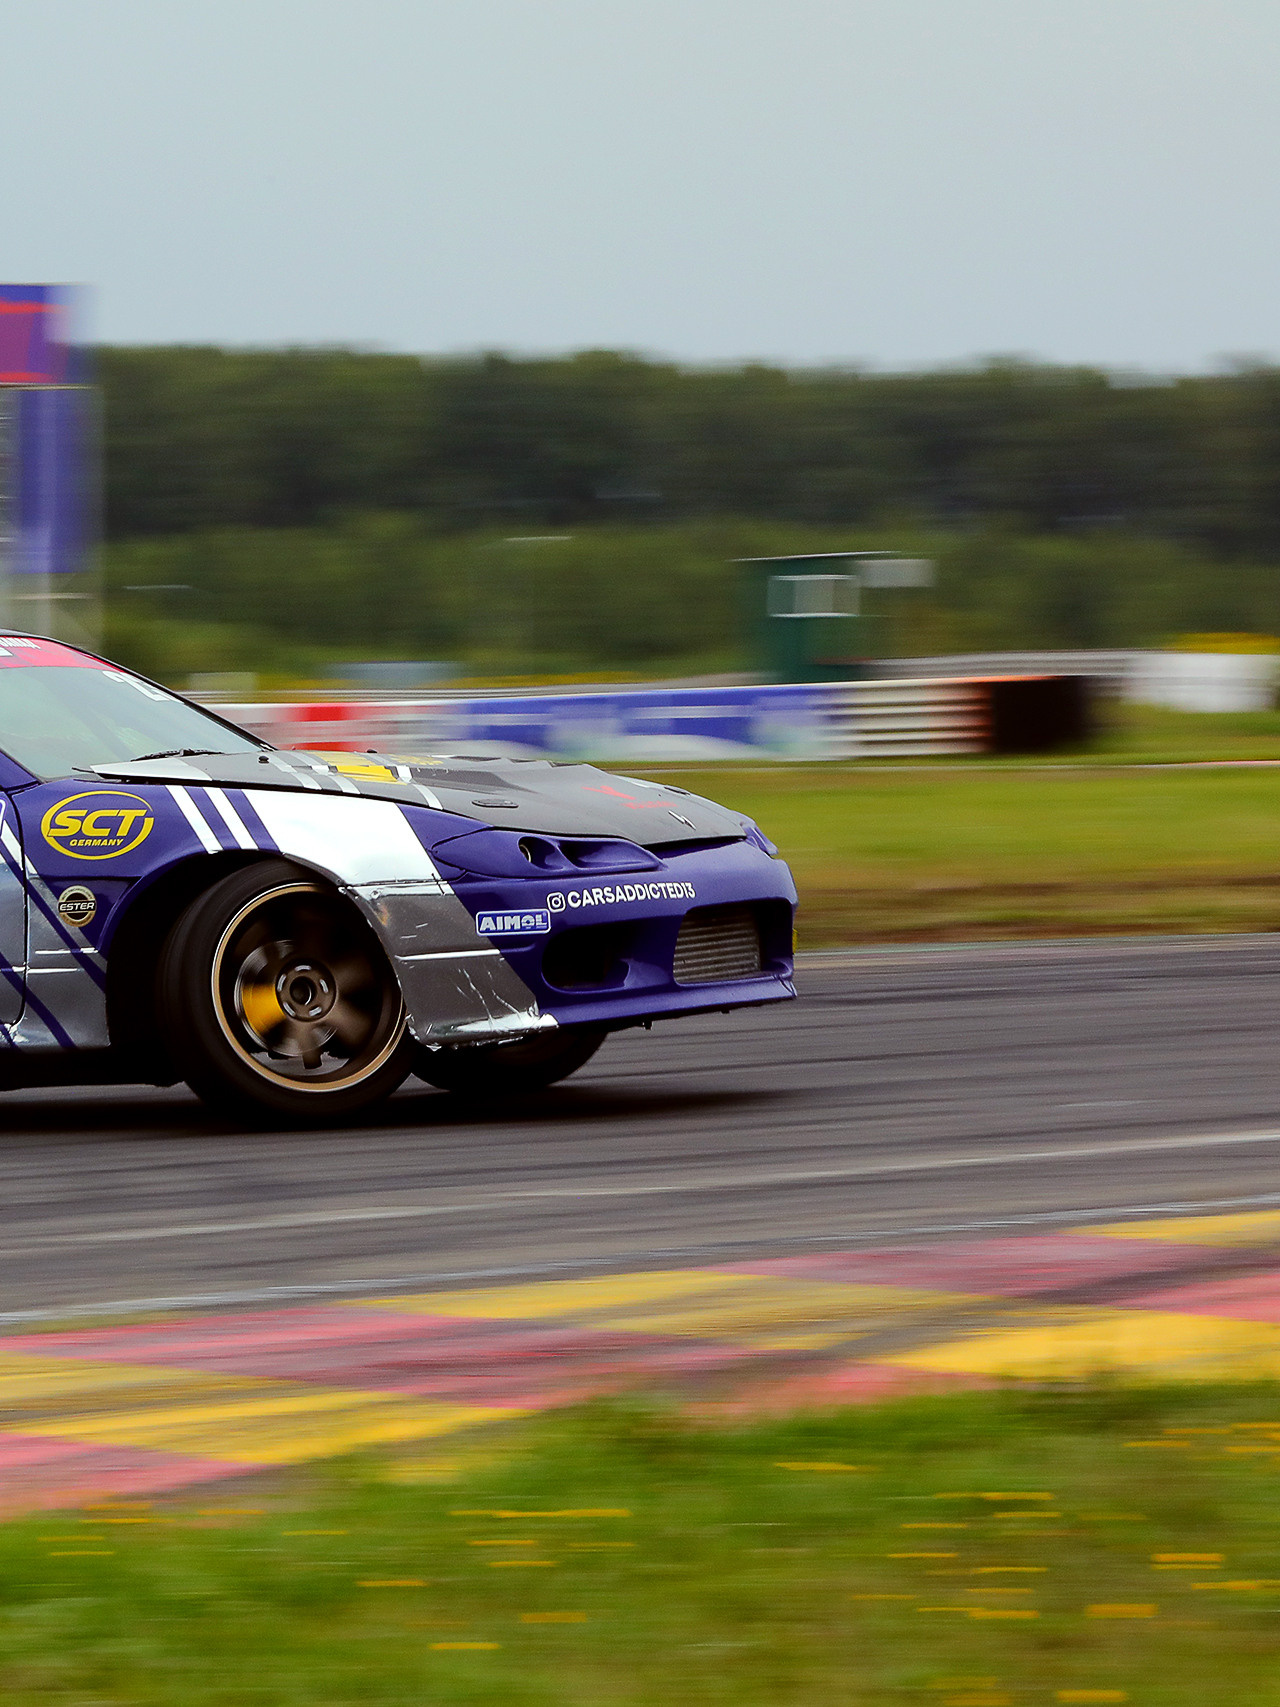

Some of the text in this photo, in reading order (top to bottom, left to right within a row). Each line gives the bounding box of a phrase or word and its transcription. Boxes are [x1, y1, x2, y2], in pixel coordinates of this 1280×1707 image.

[48, 809, 147, 837] SCT
[69, 838, 124, 847] GERMANY
[59, 901, 96, 912] ESTER
[480, 913, 548, 931] AIMOL
